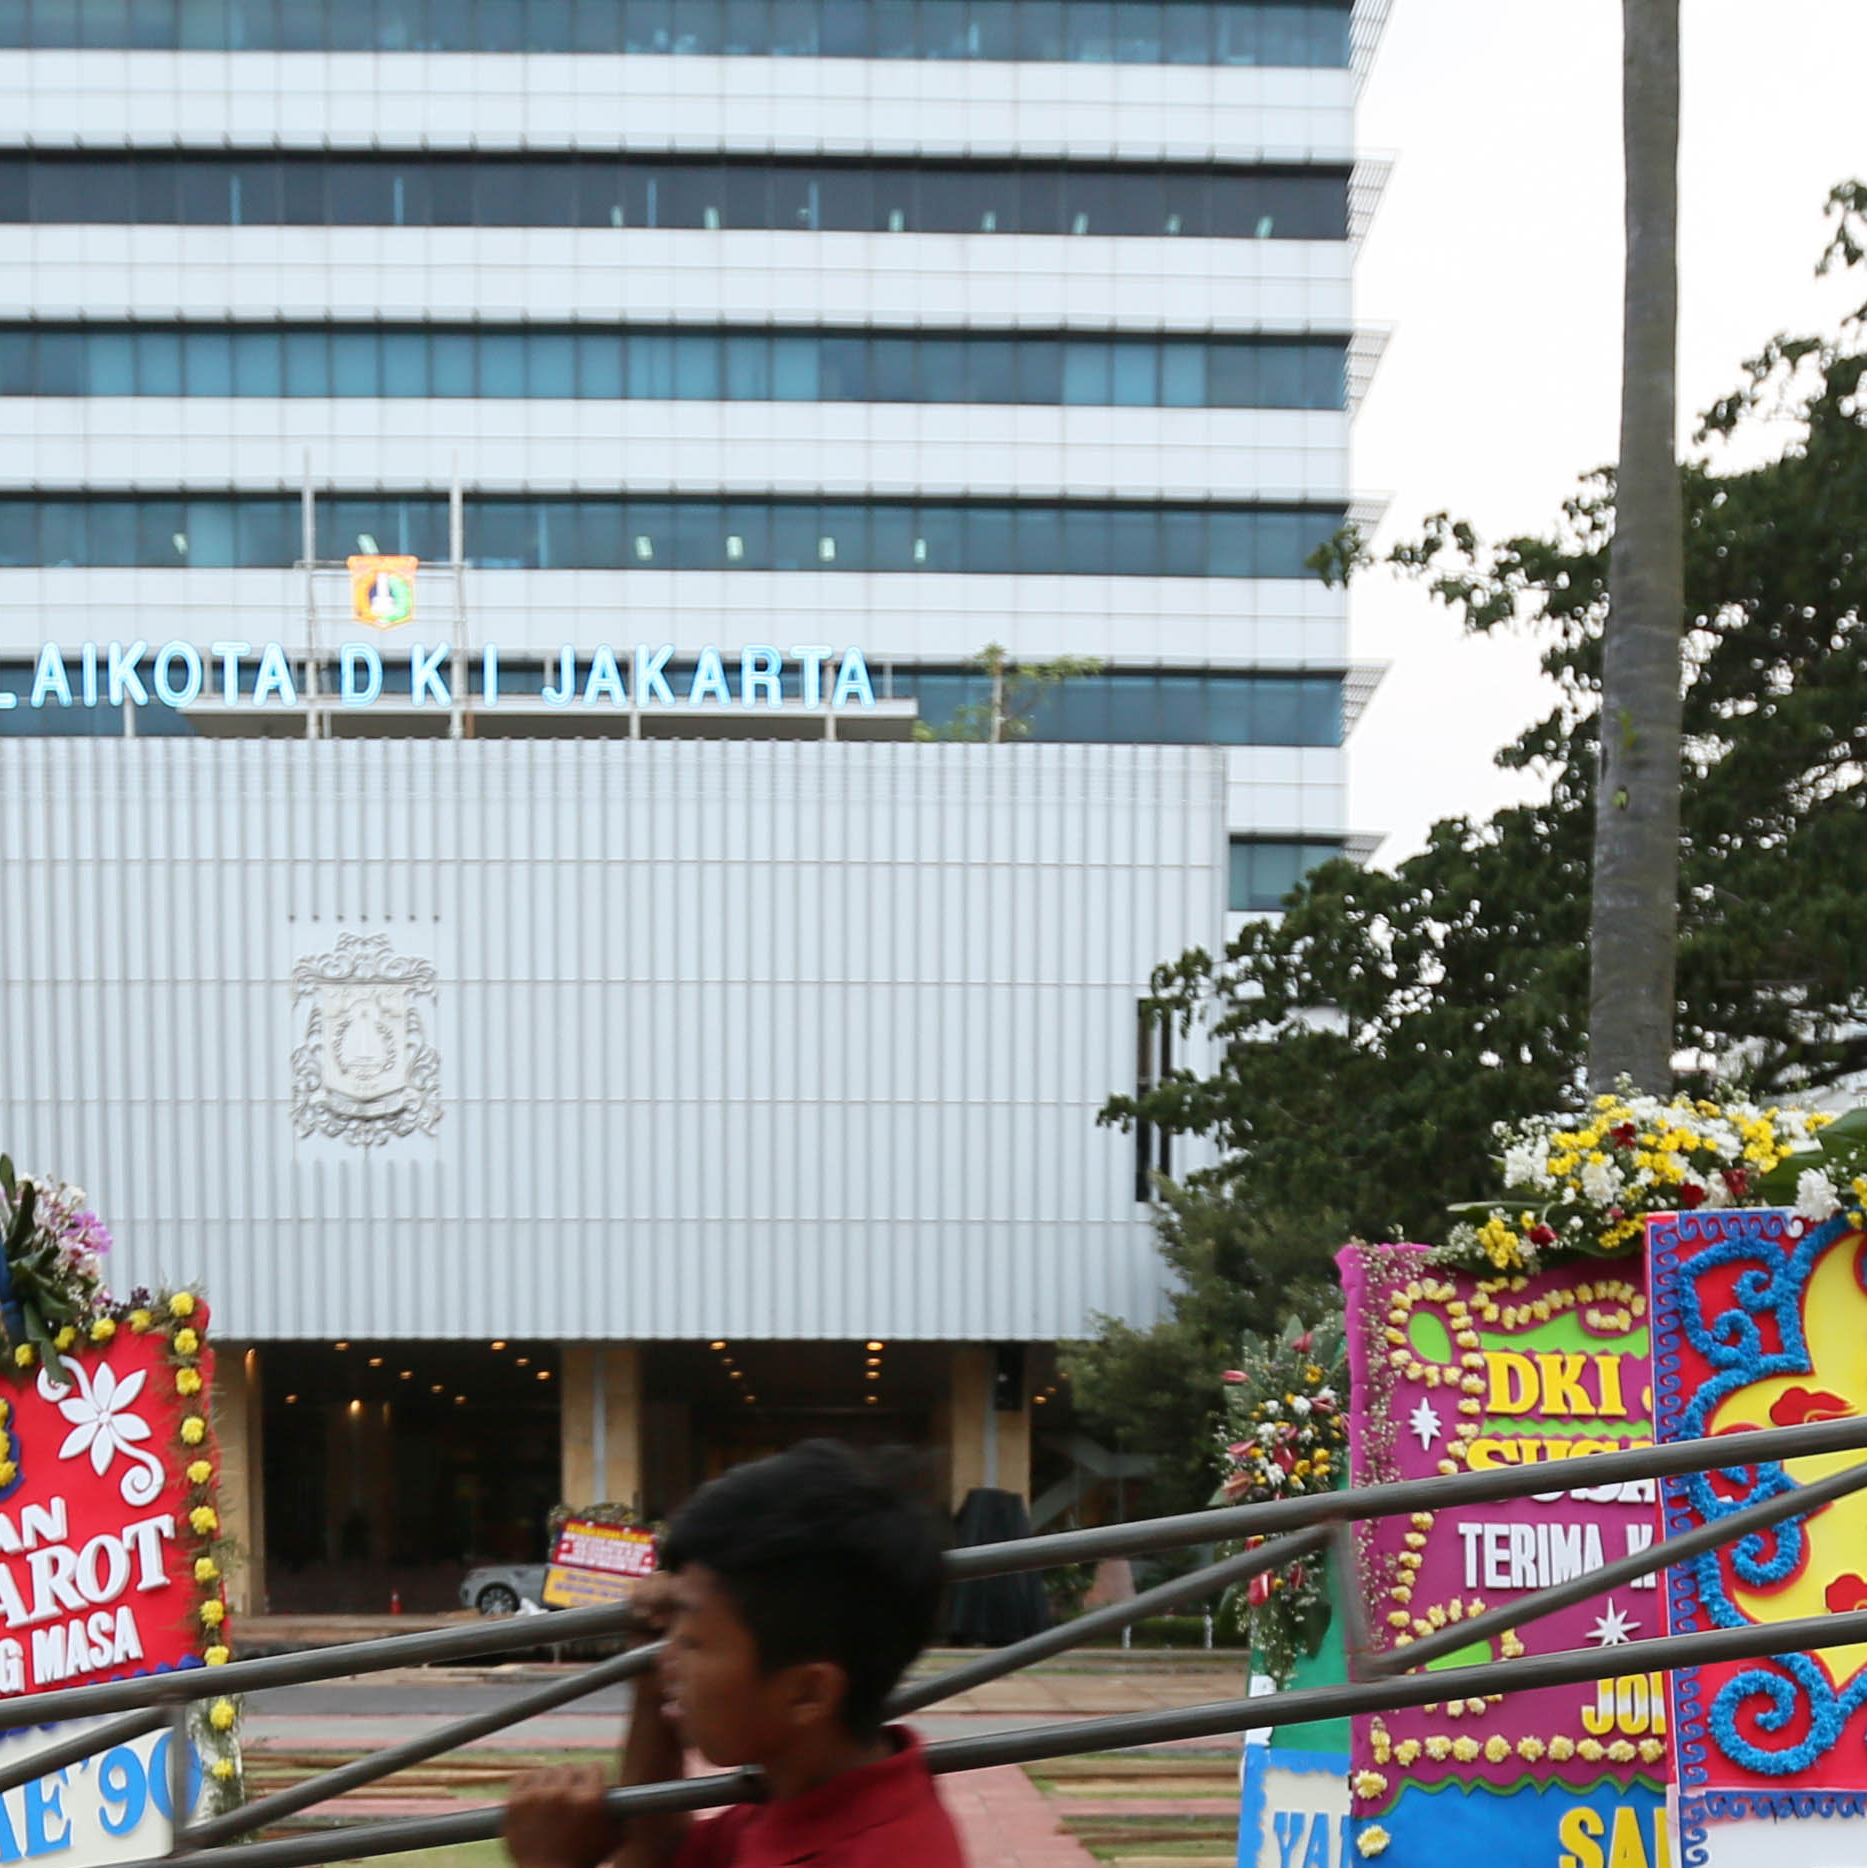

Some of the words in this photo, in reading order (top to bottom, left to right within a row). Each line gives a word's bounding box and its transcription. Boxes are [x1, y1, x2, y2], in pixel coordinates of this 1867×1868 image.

[542, 643, 877, 708] JAKARTA
[1485, 1352, 1627, 1416] DKI
[1458, 1522, 1606, 1588] TERIMA
[32, 1606, 143, 1685] MASA
